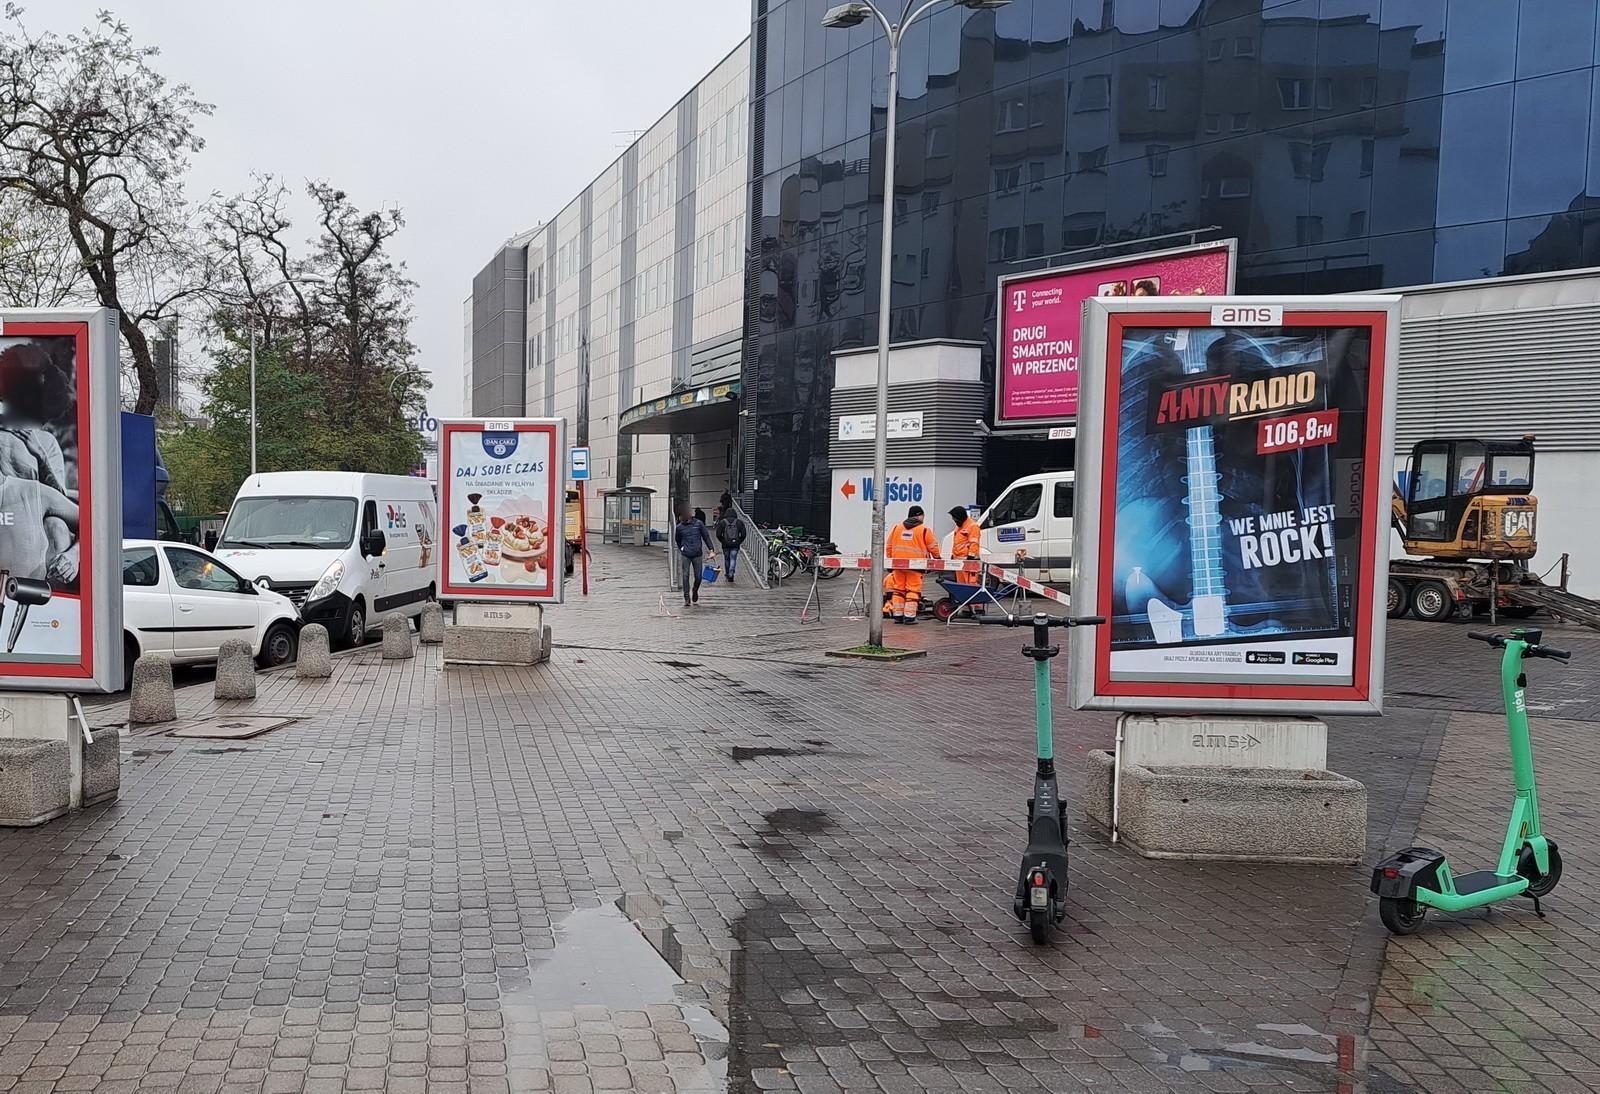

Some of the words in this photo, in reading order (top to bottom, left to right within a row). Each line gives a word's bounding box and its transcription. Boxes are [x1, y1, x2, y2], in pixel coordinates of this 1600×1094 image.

[1031, 287, 1063, 299] Connecting
[1031, 300, 1044, 308] your
[1045, 296, 1061, 306] world.
[1222, 308, 1272, 322] ams
[1013, 325, 1047, 342] DRUGI
[1012, 340, 1073, 359] SMARTFON
[1012, 362, 1025, 376] W
[488, 422, 510, 430] ams
[1051, 428, 1072, 438] ams
[456, 466, 477, 477] DAJ
[481, 463, 512, 476] SOBIE
[515, 461, 544, 474] CZAS
[862, 476, 923, 506] Wjście
[1229, 516, 1255, 536] WE
[1259, 510, 1297, 532] MNIE
[1301, 504, 1336, 525] JEST
[1504, 511, 1534, 537] CAT
[1239, 523, 1333, 570] ROCK!
[483, 611, 504, 619] ams
[1514, 689, 1525, 713] Bolt
[1192, 734, 1239, 748] ams
